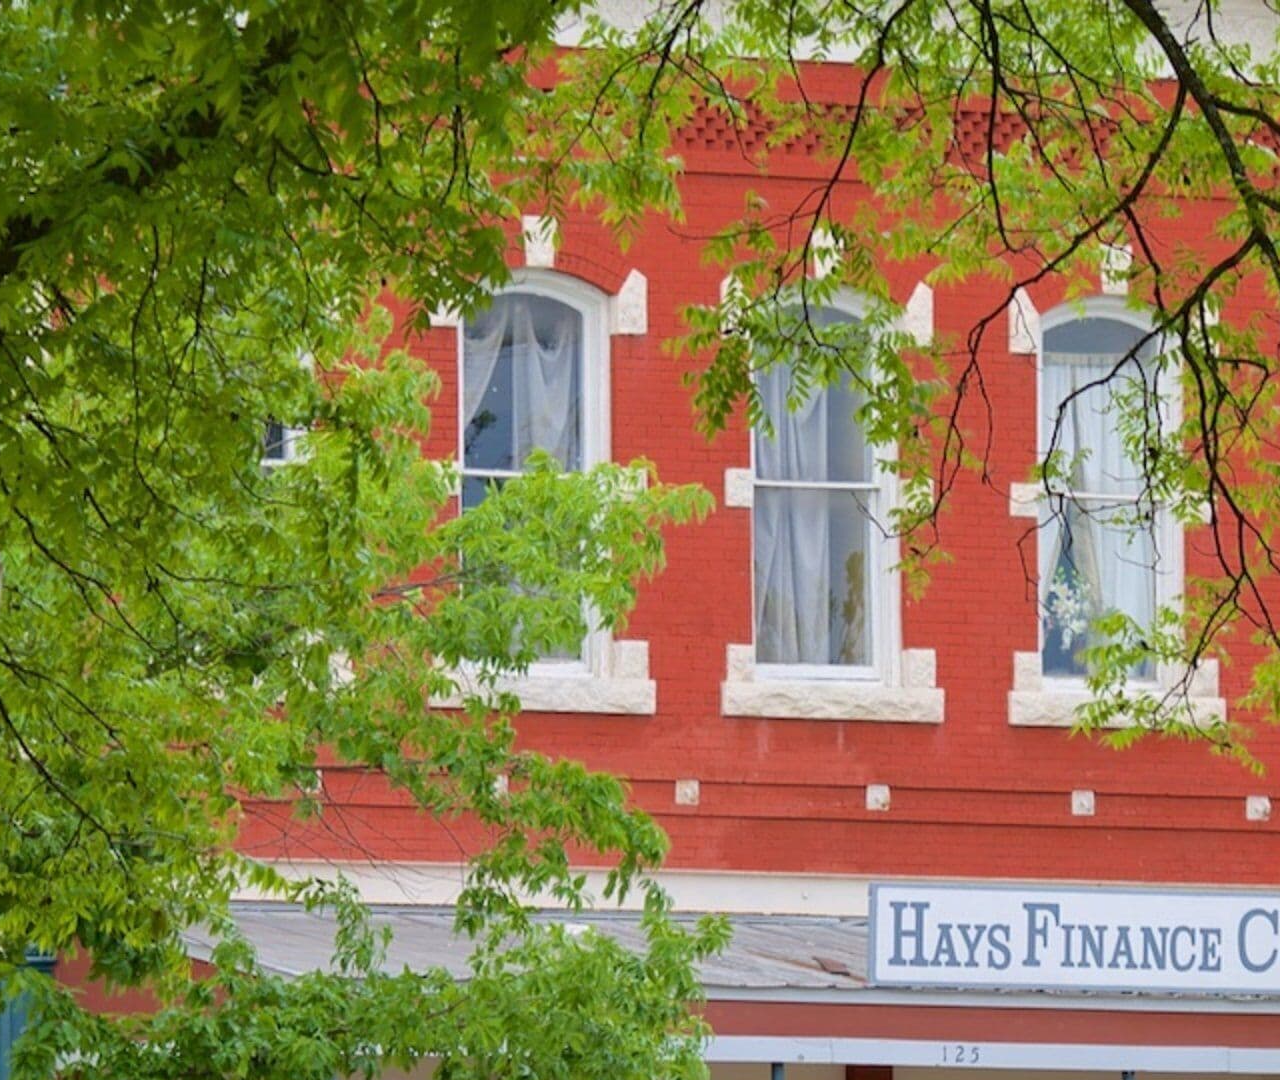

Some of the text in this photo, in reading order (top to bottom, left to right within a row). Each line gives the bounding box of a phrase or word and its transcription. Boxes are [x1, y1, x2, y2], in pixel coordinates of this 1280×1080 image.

[887, 901, 1011, 970] HAYS
[1022, 902, 1222, 972] FINANCE
[943, 1045, 980, 1064] 125
